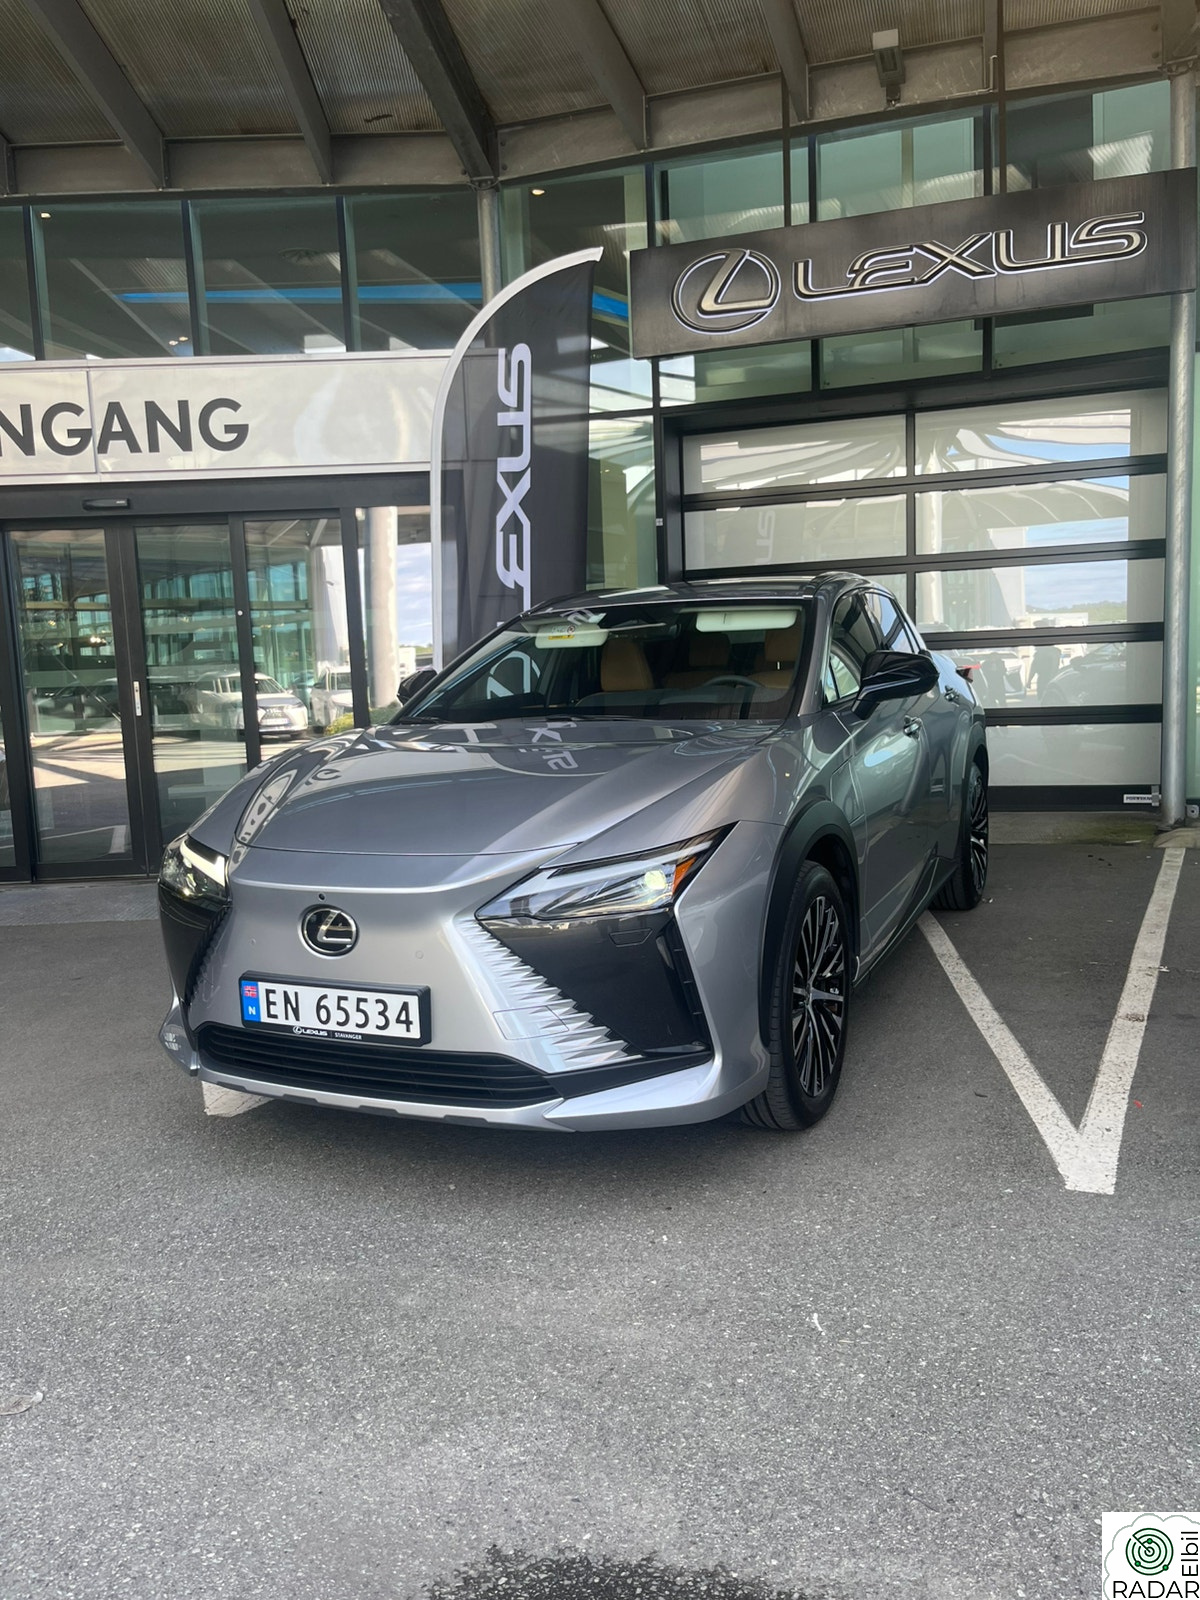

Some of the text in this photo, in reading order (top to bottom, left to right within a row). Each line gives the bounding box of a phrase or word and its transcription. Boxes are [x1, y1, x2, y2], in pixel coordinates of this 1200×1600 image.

[792, 210, 1148, 302] LEXUS
[0, 398, 249, 457] NGANG
[496, 342, 533, 615] EXUS
[248, 1005, 257, 1016] N
[265, 988, 414, 1033] EN 65534
[302, 1028, 363, 1041] LEXUS STAVANGER
